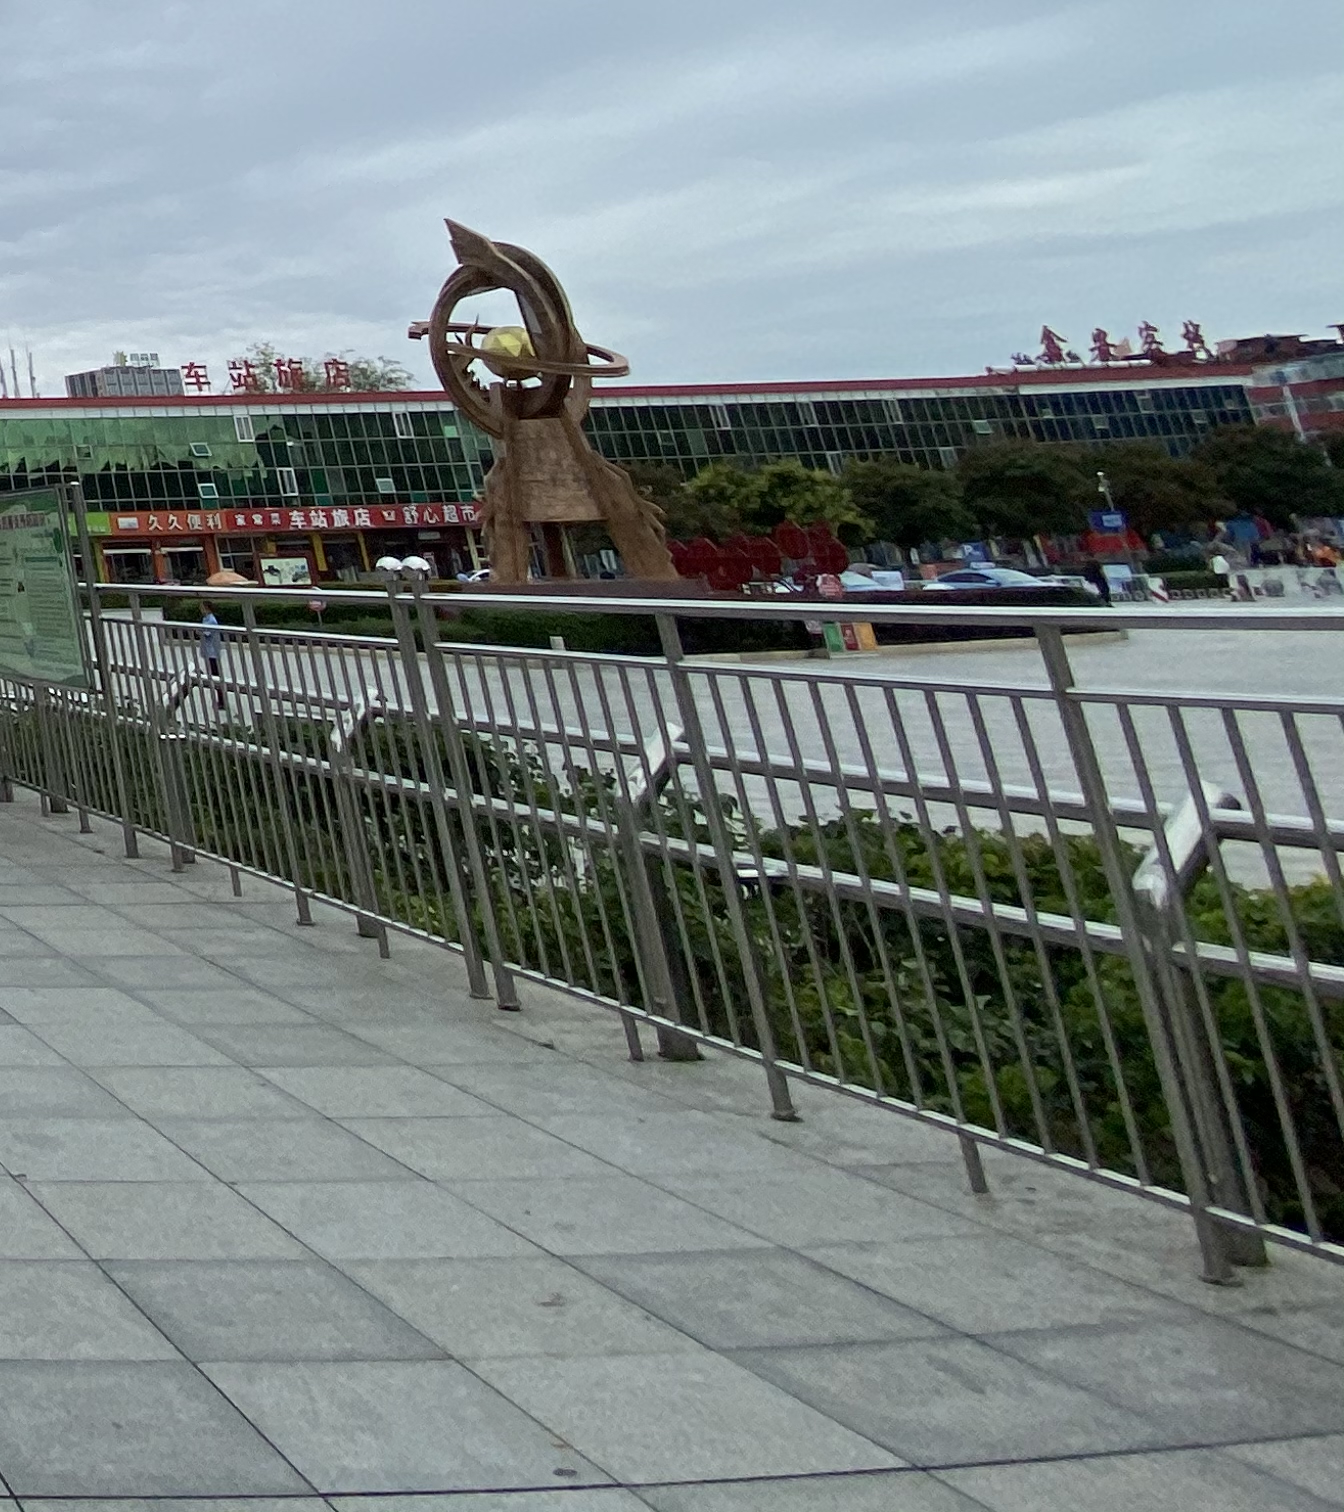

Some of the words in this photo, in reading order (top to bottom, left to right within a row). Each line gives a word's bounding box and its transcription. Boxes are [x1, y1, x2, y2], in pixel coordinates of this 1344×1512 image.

[180, 358, 350, 393] 车站旅店
[148, 513, 223, 532] 久久便利
[289, 508, 372, 530] 车站旅店
[402, 504, 480, 526] 舒心超市
